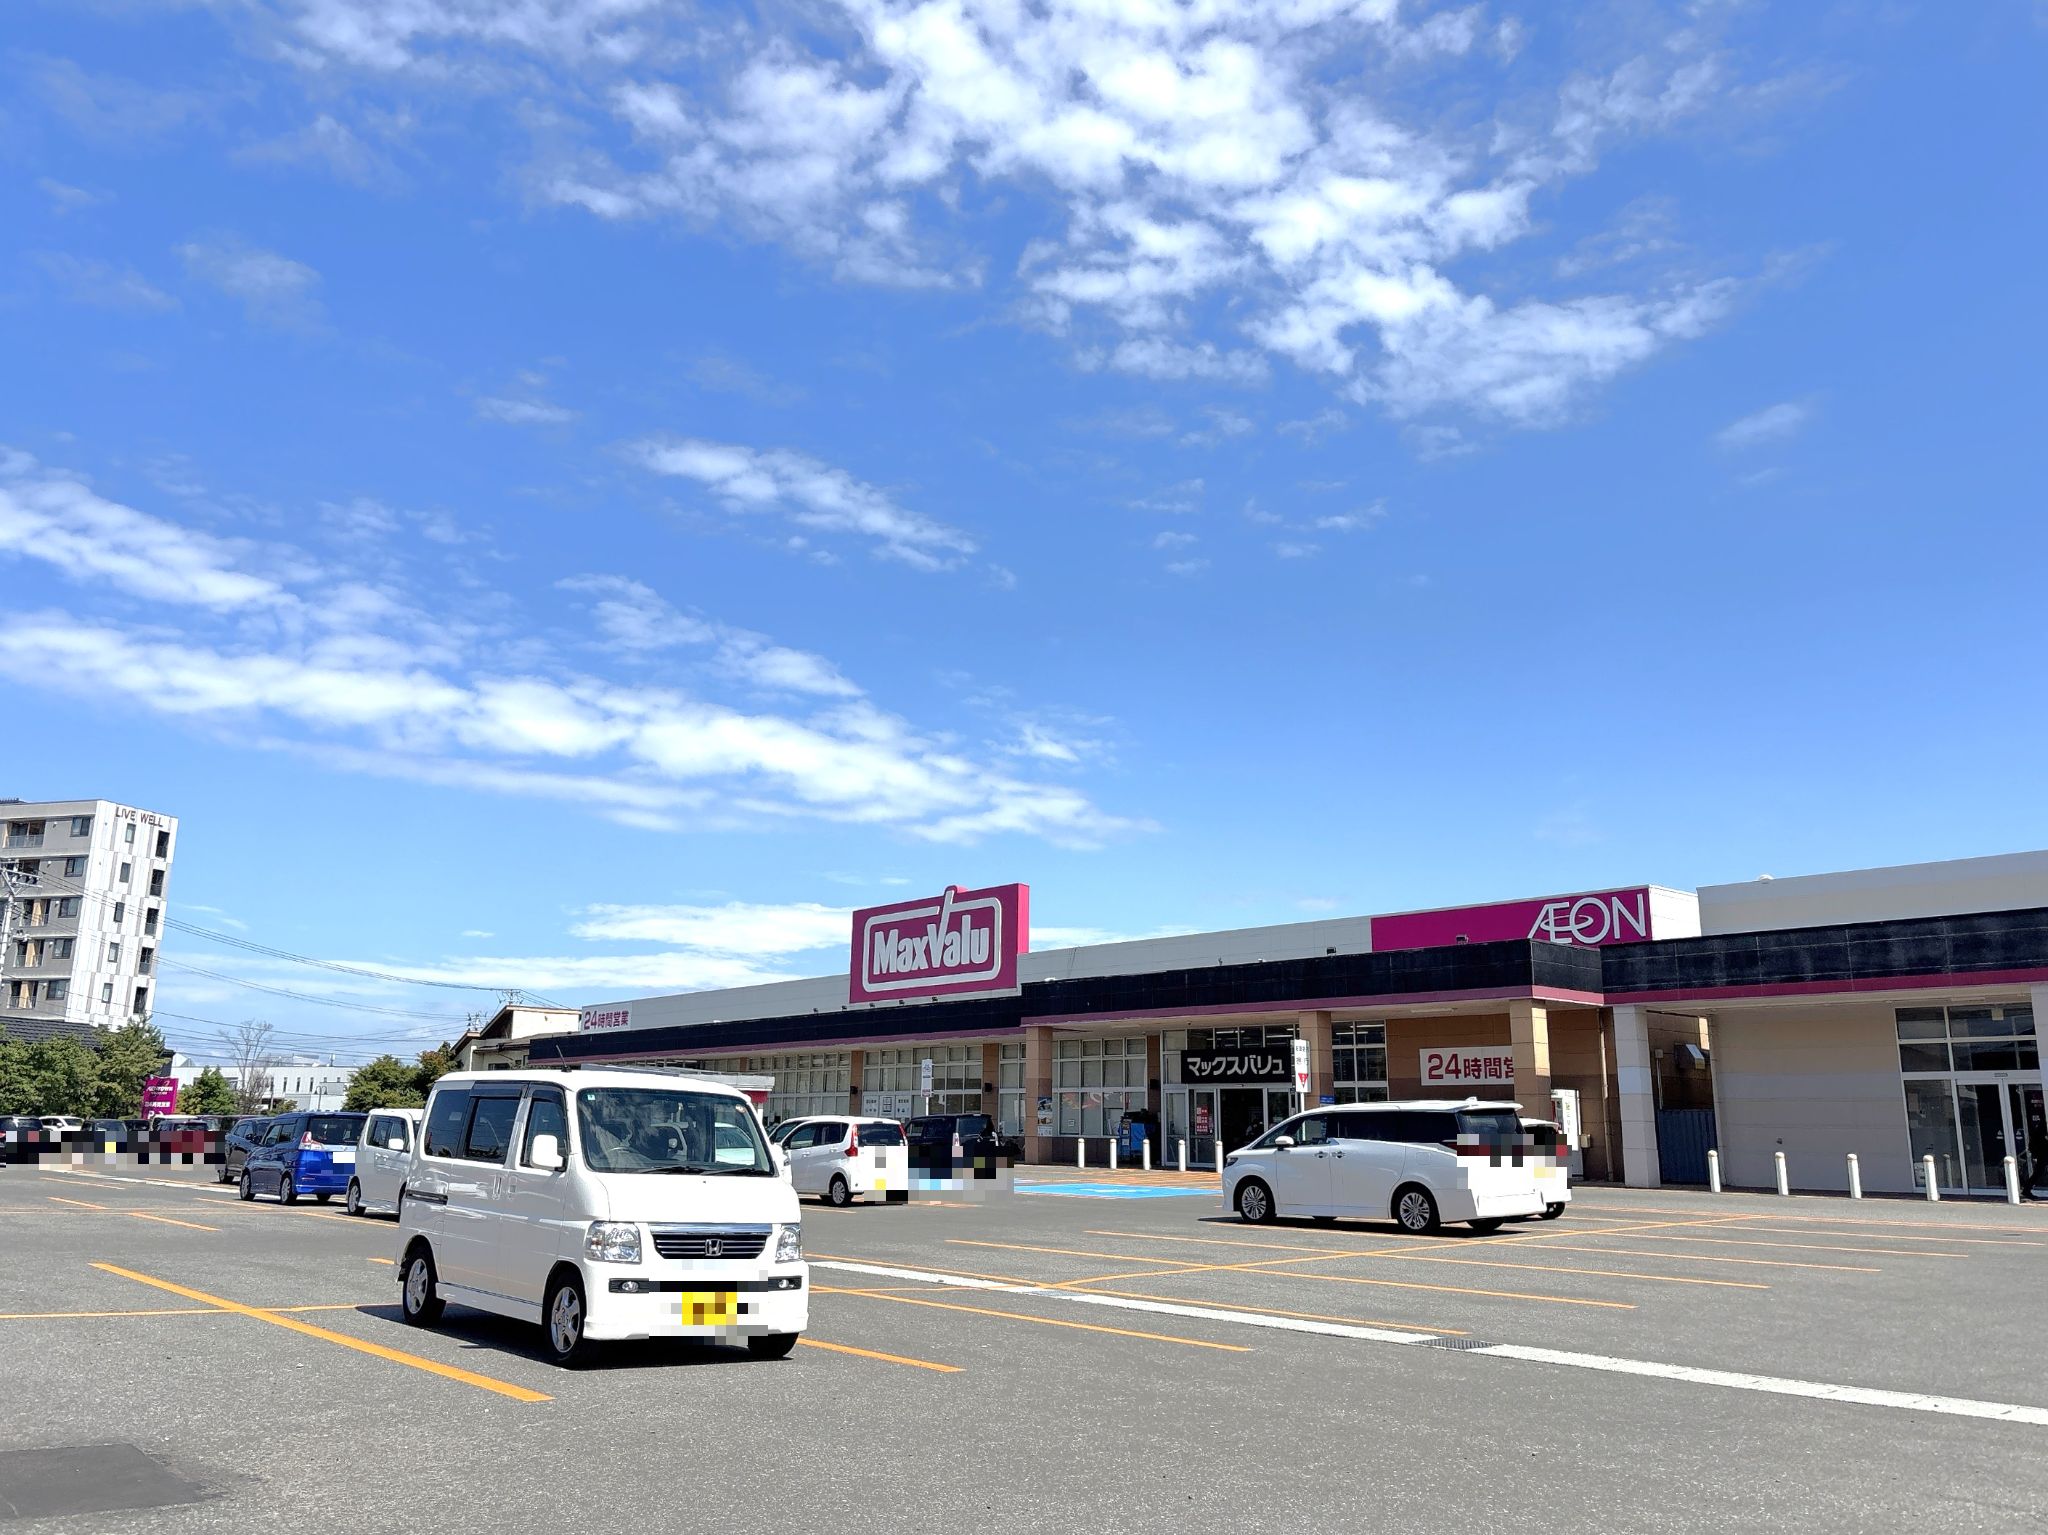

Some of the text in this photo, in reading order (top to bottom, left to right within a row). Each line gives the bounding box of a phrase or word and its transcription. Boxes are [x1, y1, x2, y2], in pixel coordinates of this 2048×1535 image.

[115, 806, 163, 828] LIVE WELL
[873, 890, 990, 976] MaxValu
[583, 1010, 630, 1031] 24時間営業
[1187, 1054, 1285, 1077] マックスバリュ
